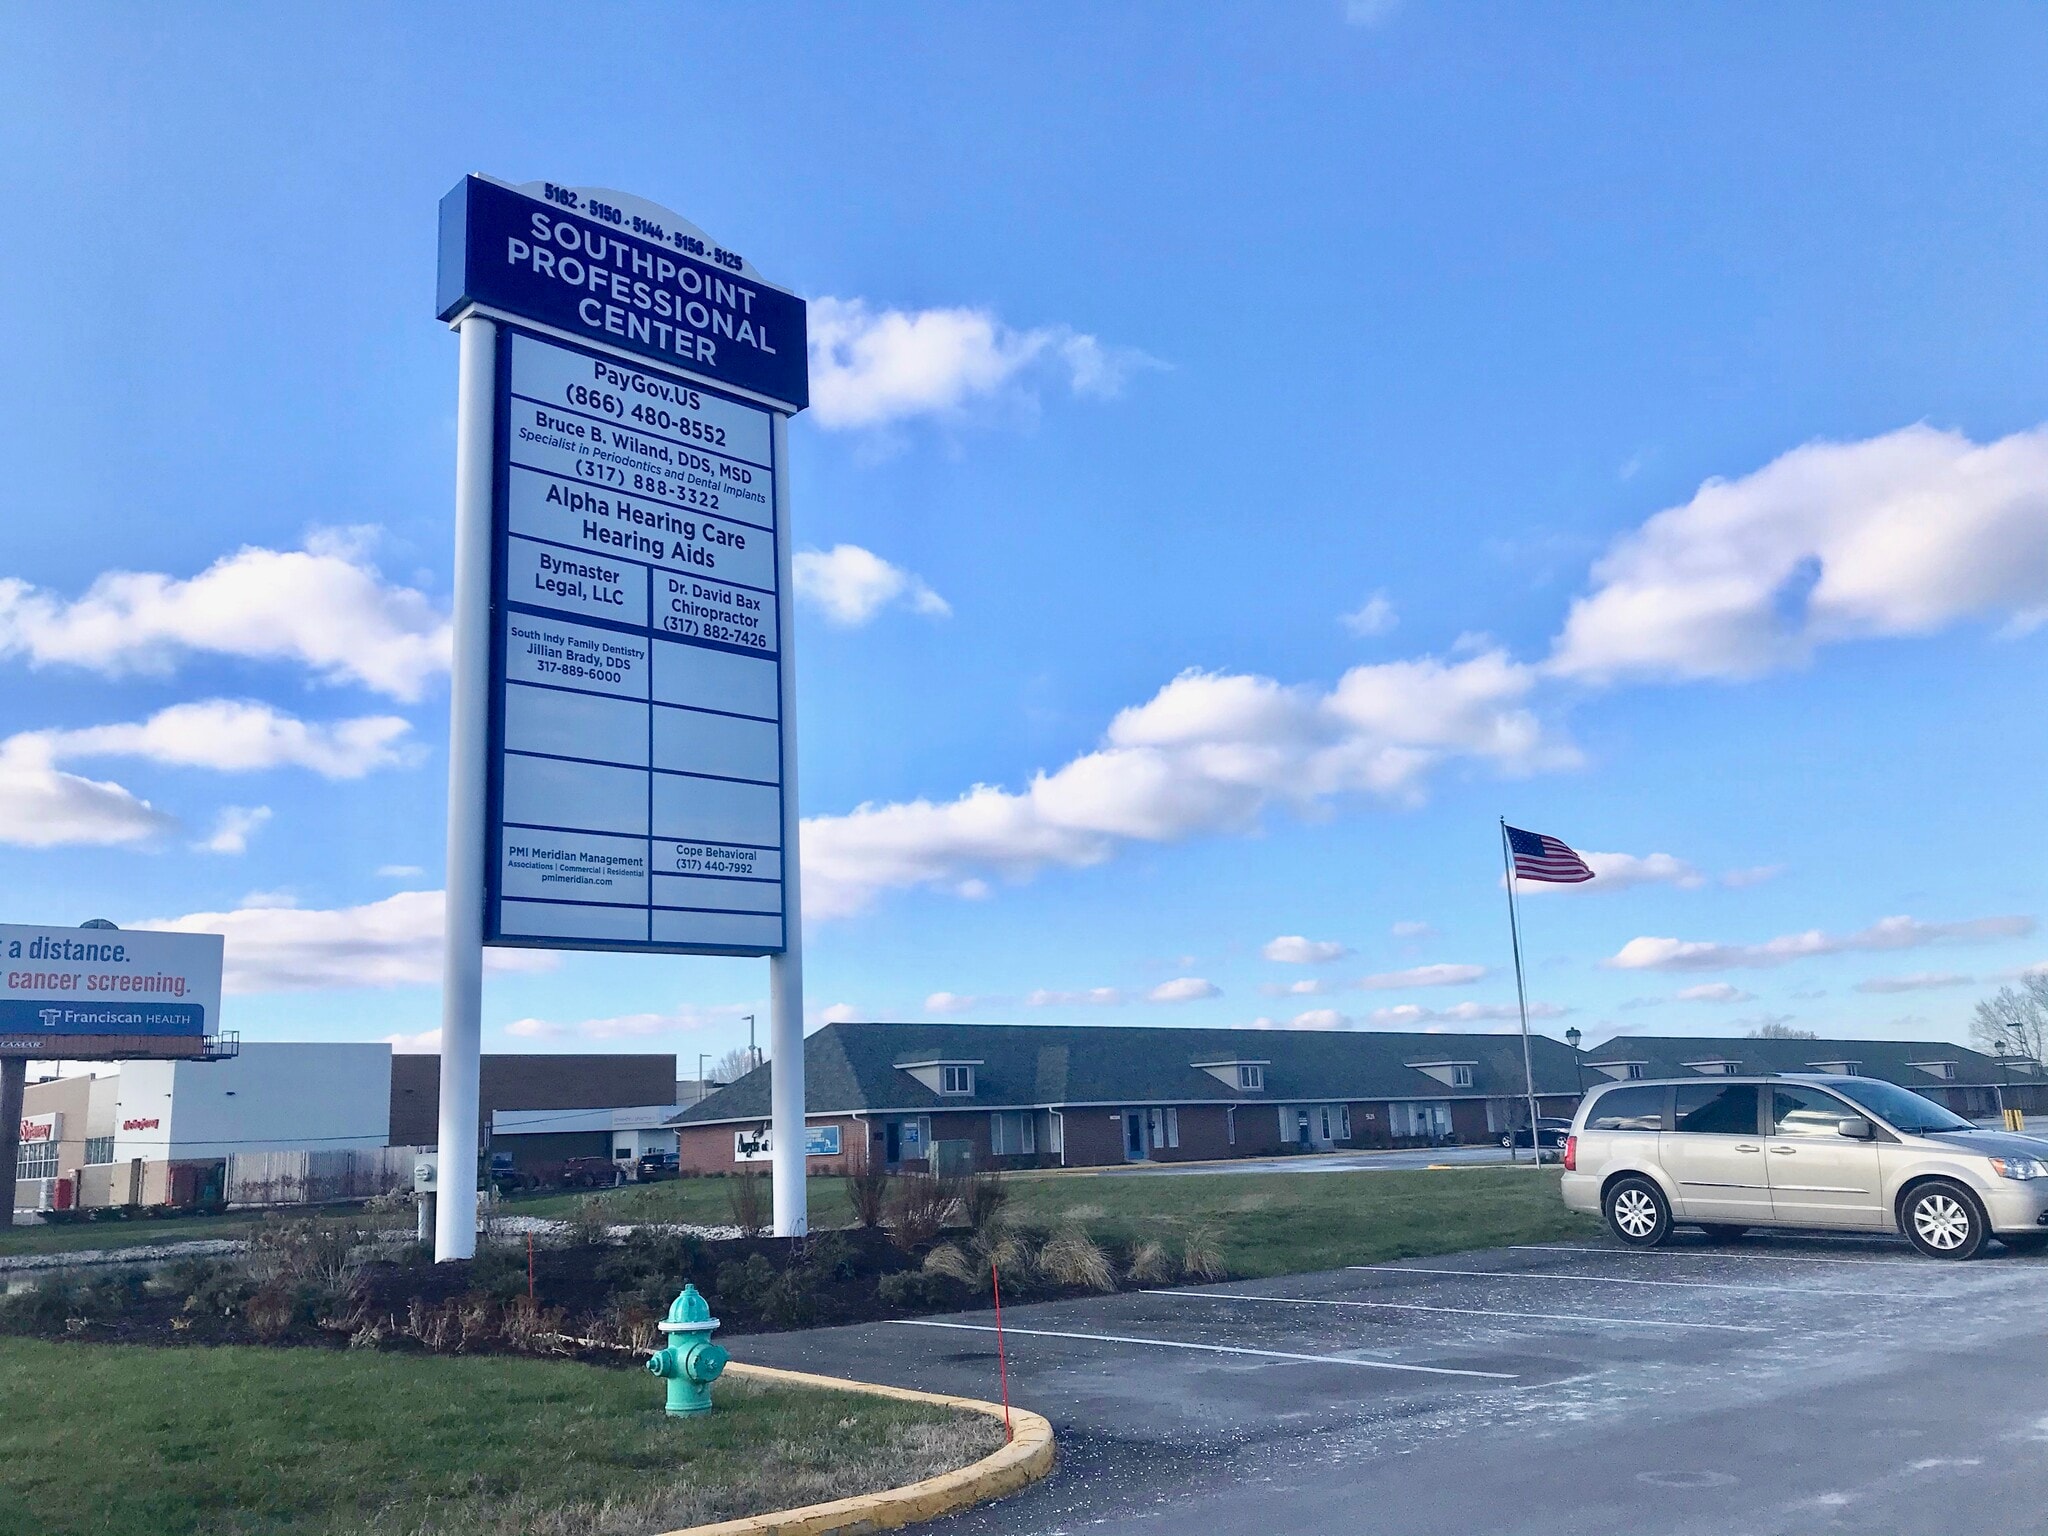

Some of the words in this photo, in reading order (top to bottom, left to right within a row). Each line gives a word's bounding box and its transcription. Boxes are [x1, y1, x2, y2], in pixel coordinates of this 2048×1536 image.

[590, 199, 621, 224] 5150
[633, 216, 664, 241] 5144
[714, 247, 743, 271] 5125
[531, 212, 756, 315] SOUTHPOINT
[508, 236, 776, 355] PROFESSIONAL
[579, 298, 716, 366] CENTER
[594, 361, 701, 410] PayGov.US
[566, 383, 624, 418] (866)
[631, 404, 726, 447] 480-8552
[536, 411, 585, 438] Bruce
[591, 426, 607, 444] B.
[612, 432, 673, 464] Wiland,
[678, 451, 715, 477] DDS,
[719, 463, 752, 484] MSD
[518, 428, 576, 452] Specialist
[578, 443, 590, 456] in
[592, 447, 661, 476] Periodontics
[664, 467, 684, 481] and
[687, 473, 721, 491] Dental
[723, 483, 766, 504] Implants
[576, 459, 624, 487] (317)
[634, 475, 719, 510] 888-3322
[545, 483, 609, 517] Alpha
[617, 501, 695, 540] Hearing
[702, 523, 746, 550] Care
[583, 520, 664, 560] Hearing
[671, 541, 715, 568] Aids
[540, 553, 619, 584] Bymaster
[535, 573, 587, 601] Legal,
[593, 587, 624, 606] LLC
[668, 579, 688, 596] Dr.
[692, 584, 732, 605] David
[736, 593, 761, 611] Bax
[671, 599, 759, 629] Chiropractor
[511, 627, 541, 640] South
[543, 632, 565, 646] Indy
[567, 637, 600, 652] Family
[602, 643, 645, 660] Dentistry
[664, 615, 699, 636] (317)
[703, 626, 766, 648] 882-7426
[527, 642, 562, 659] Jillian
[566, 651, 603, 668] Brady,
[606, 656, 631, 670] DDS
[537, 660, 621, 684] 317-889-6000
[508, 860, 553, 870] Associations
[559, 864, 601, 874] Commercial
[607, 868, 644, 877] Residential
[509, 846, 528, 858] PMI
[532, 848, 576, 861] Meridian
[579, 852, 643, 867] Management
[676, 844, 703, 858] Cope
[705, 847, 757, 861] Behavioral
[676, 859, 702, 871] (317)
[705, 861, 752, 874] 440-7992
[542, 874, 613, 886] pmimeridian.com
[9, 940, 21, 959] a
[29, 936, 130, 962] distance.
[8, 971, 82, 990] cancer
[87, 972, 191, 997] screening.
[64, 1010, 142, 1024] Franciscan
[146, 1014, 190, 1025] HEALTH
